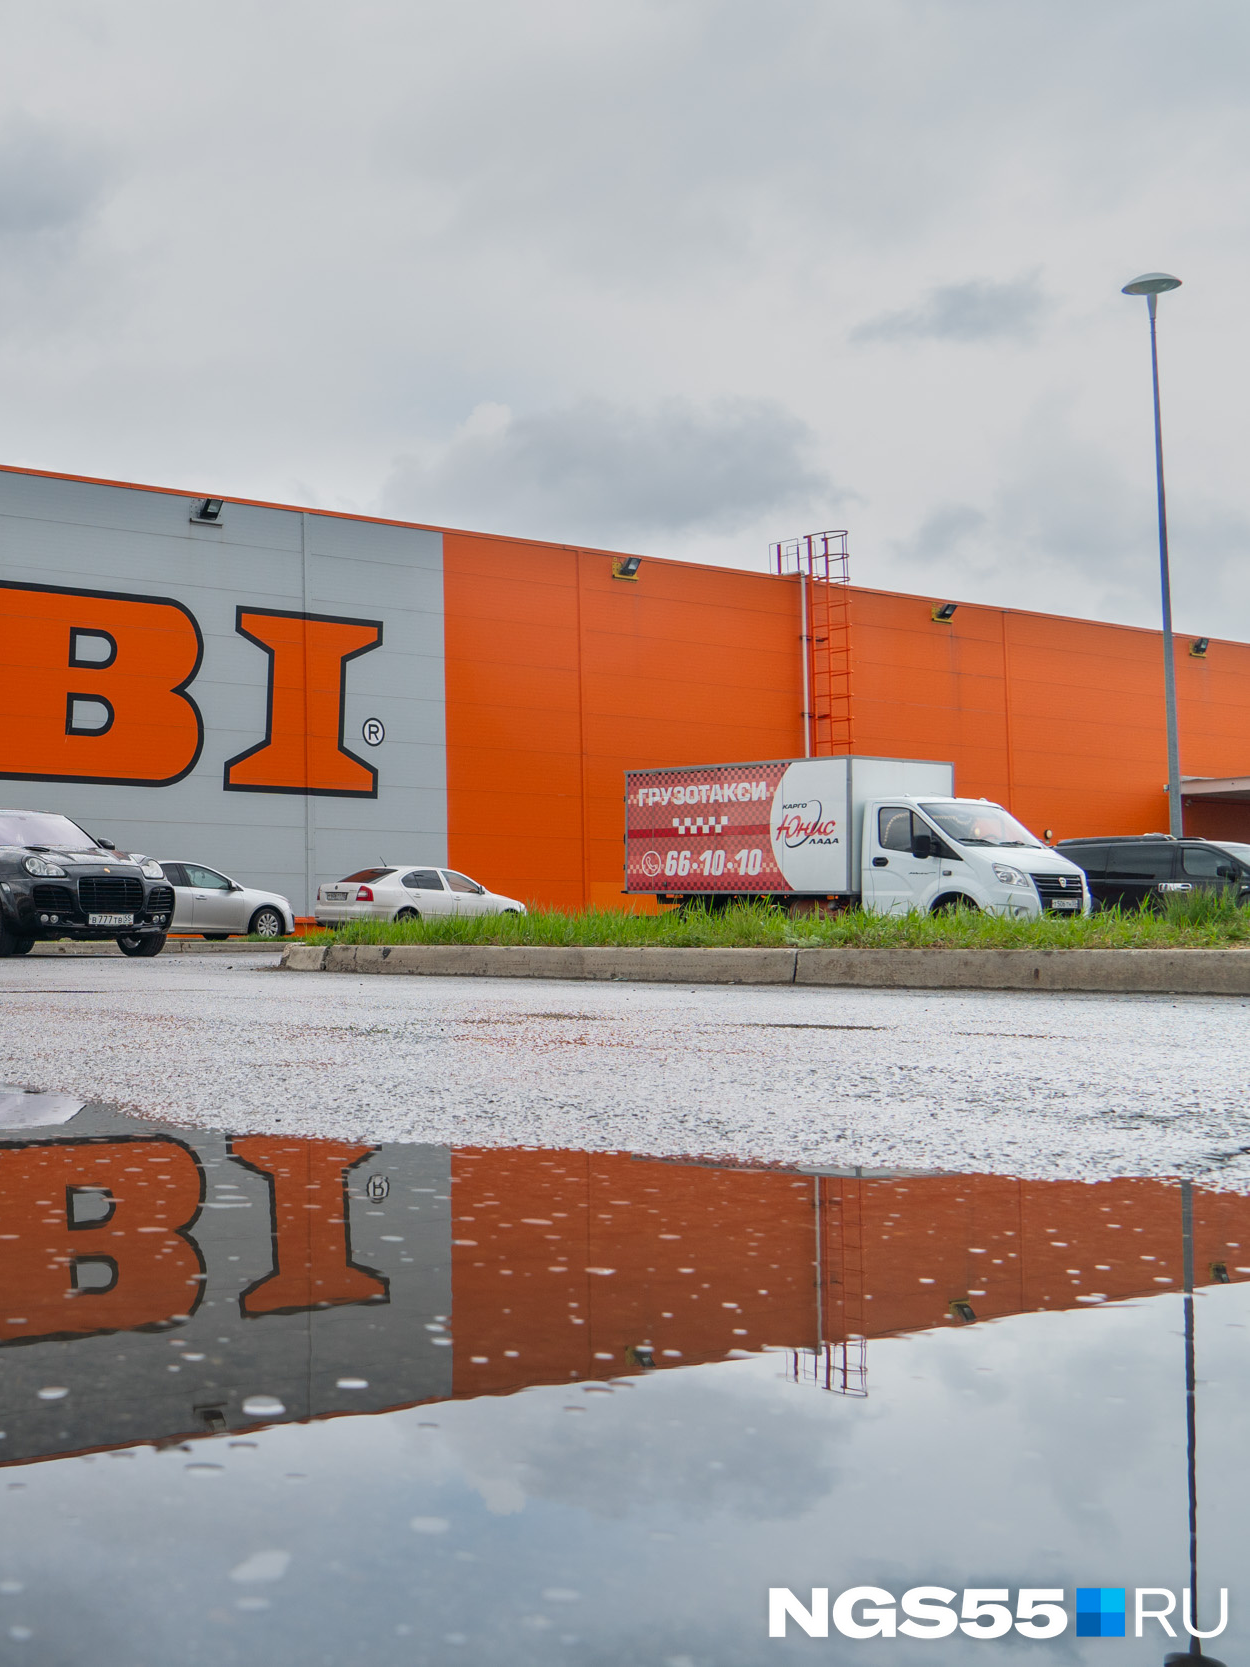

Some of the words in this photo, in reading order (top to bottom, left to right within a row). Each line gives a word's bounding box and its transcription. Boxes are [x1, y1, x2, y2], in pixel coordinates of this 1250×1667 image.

[638, 781, 767, 807] ГРУЗОТАКСИ
[782, 802, 807, 810] КАРГО
[776, 814, 836, 841] Юнис
